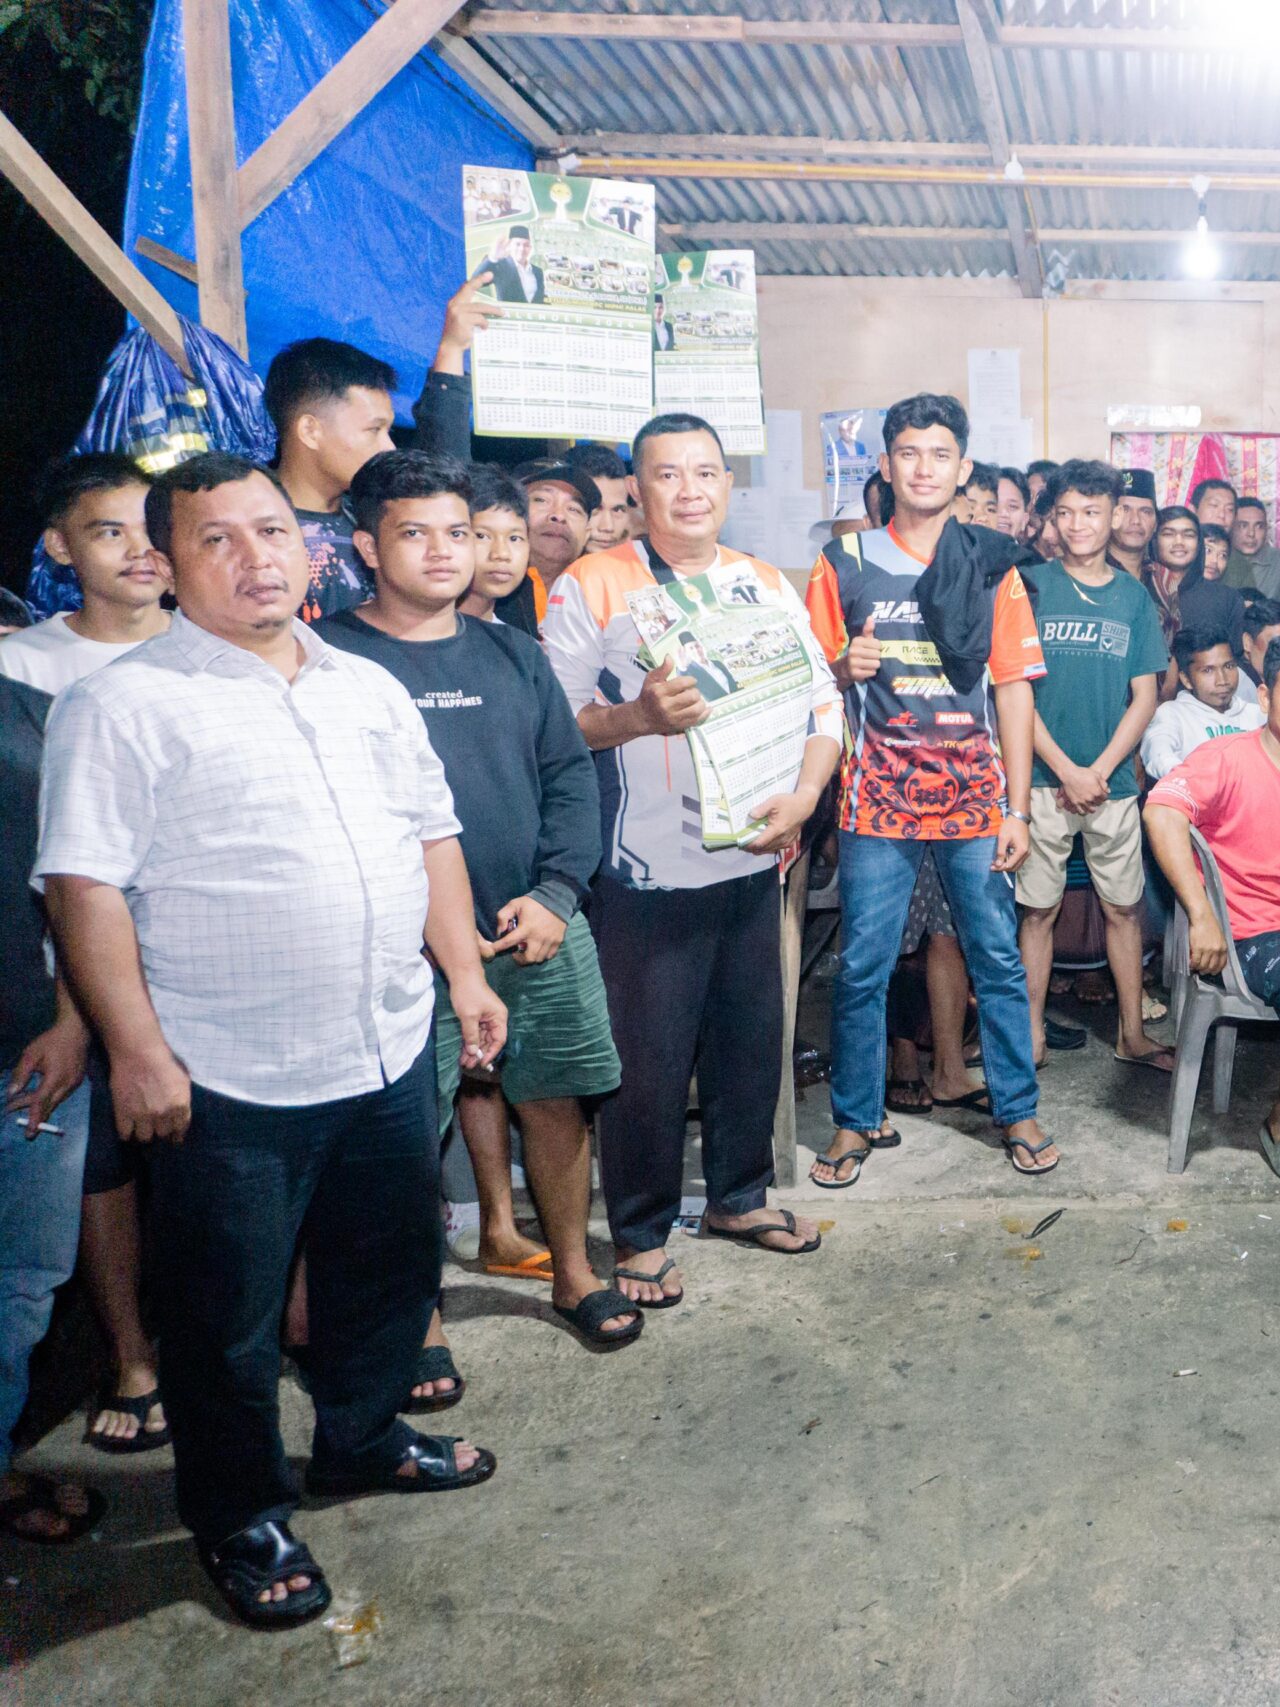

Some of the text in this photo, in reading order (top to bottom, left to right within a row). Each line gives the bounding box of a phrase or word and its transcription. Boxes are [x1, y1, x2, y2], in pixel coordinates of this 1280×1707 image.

[502, 310, 583, 325] ALENDER
[1042, 621, 1099, 642] BULL
[902, 645, 928, 655] RACE
[425, 689, 463, 699] created
[937, 713, 974, 724] MOTUL
